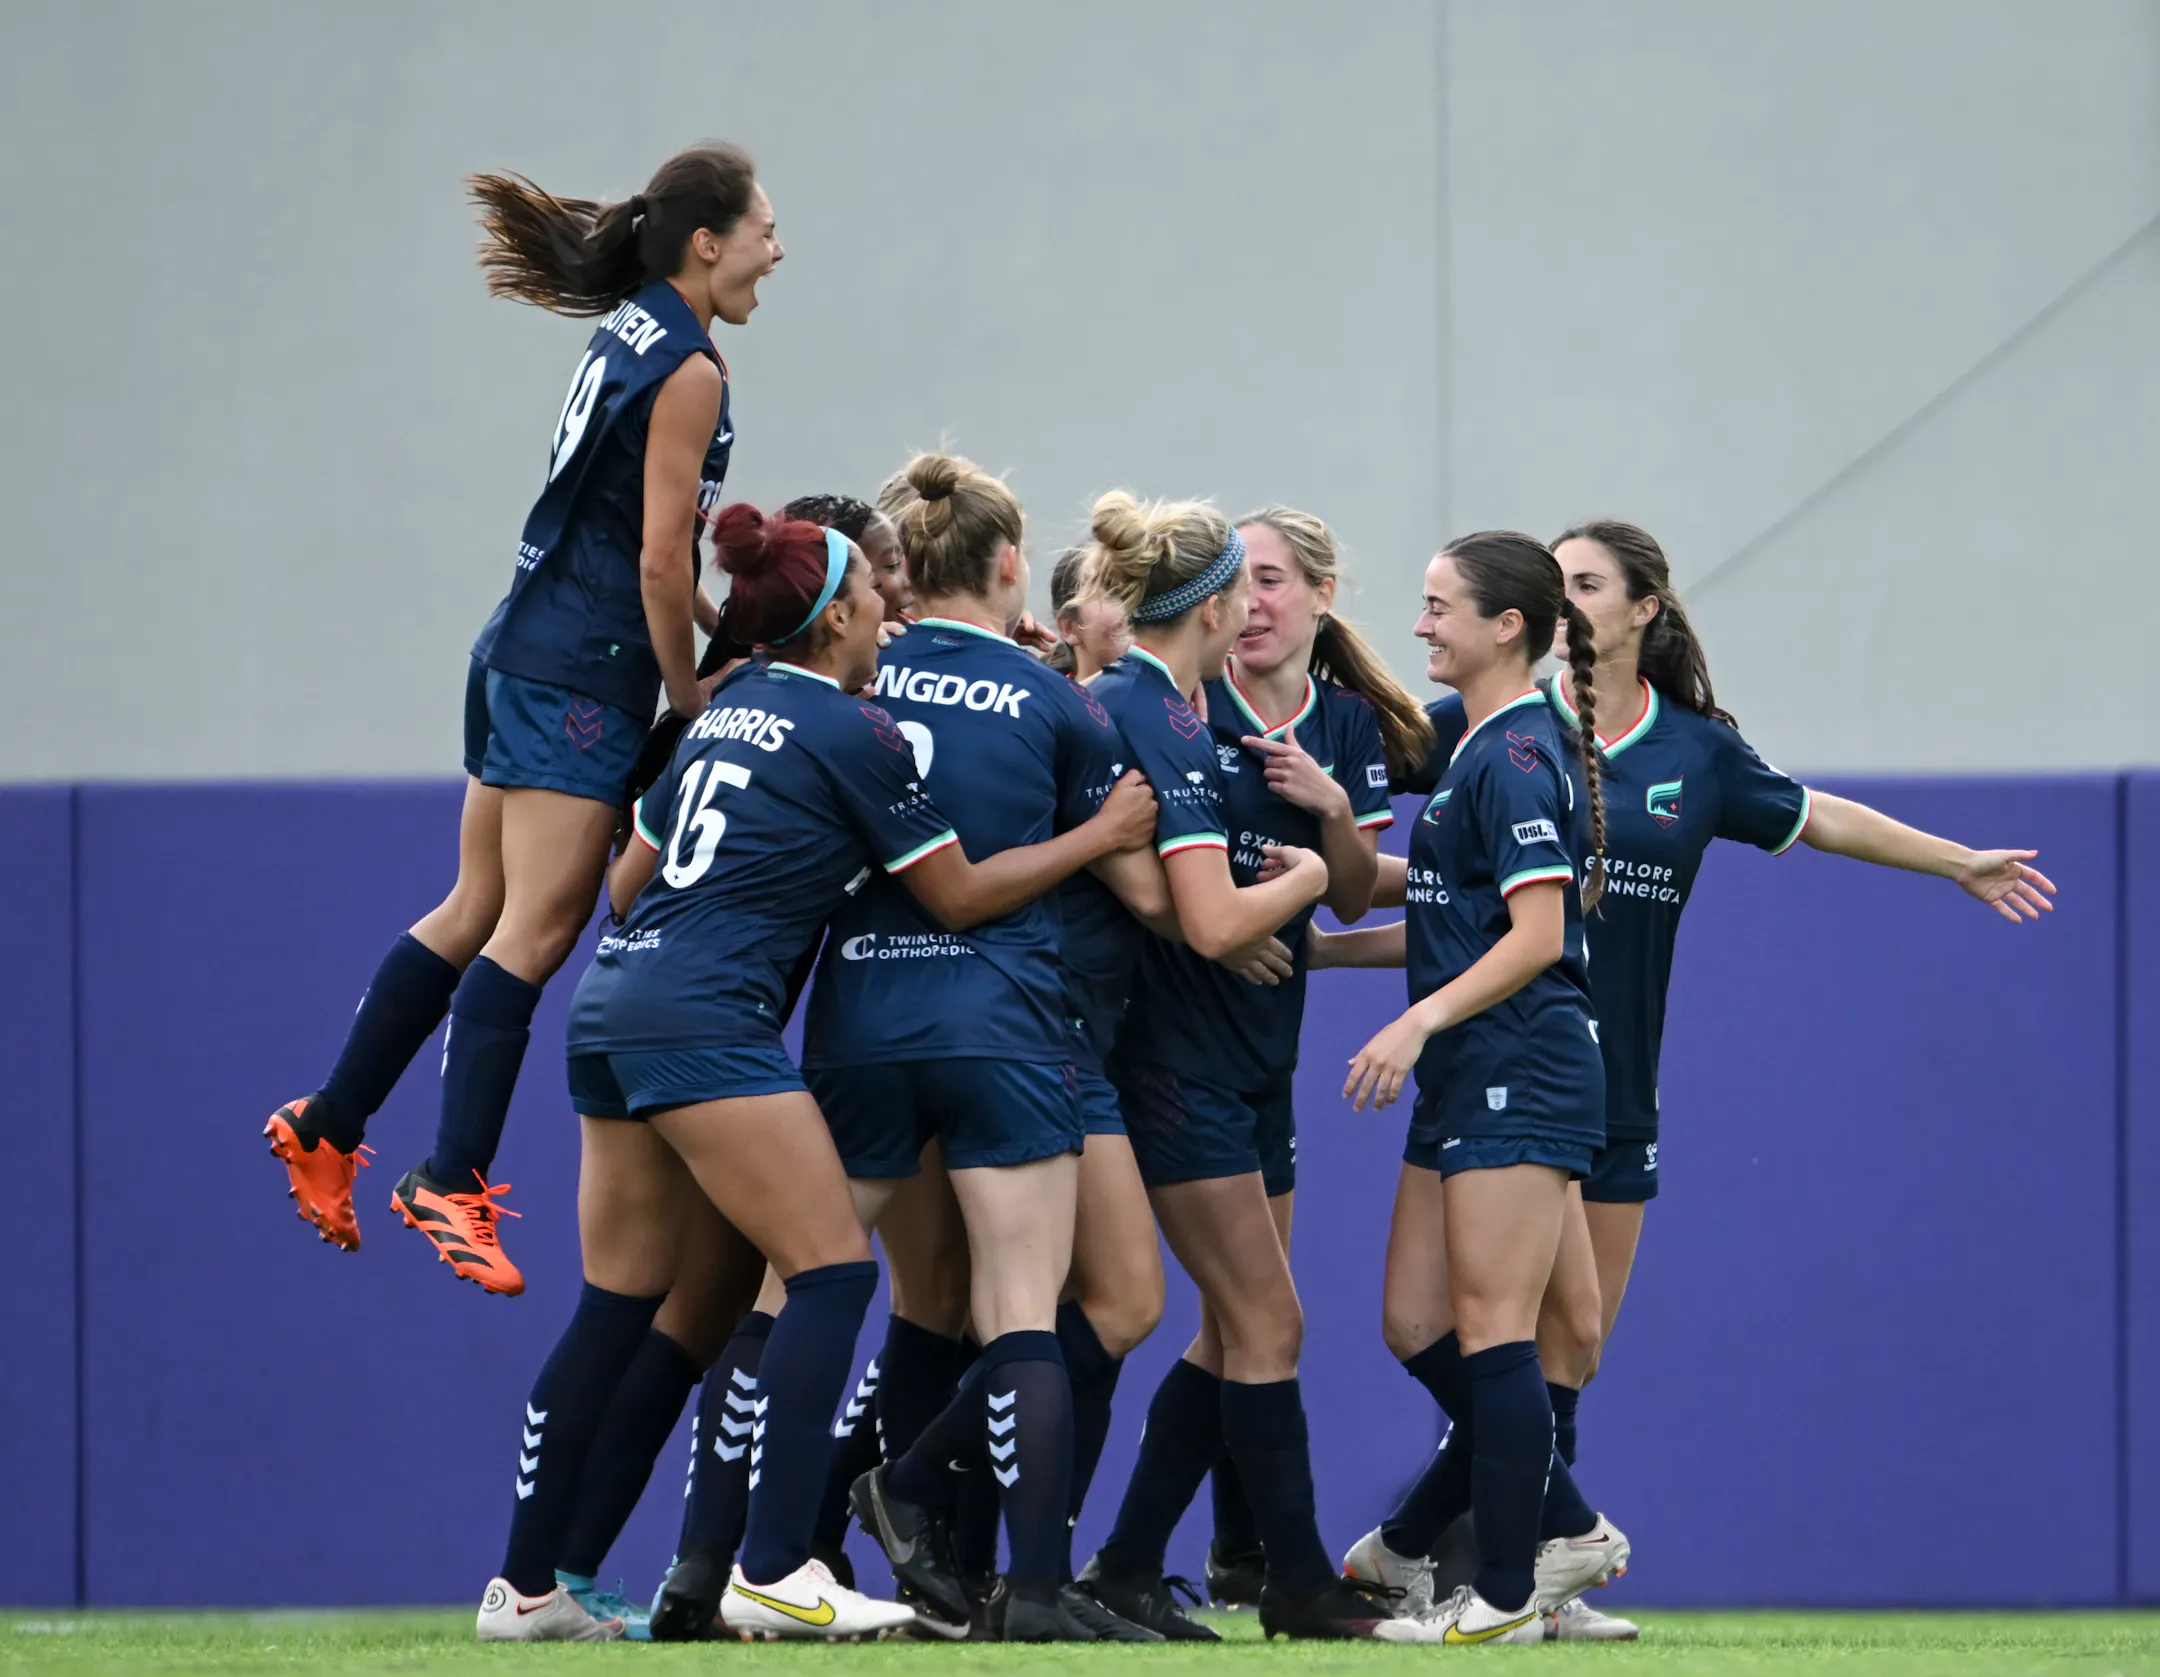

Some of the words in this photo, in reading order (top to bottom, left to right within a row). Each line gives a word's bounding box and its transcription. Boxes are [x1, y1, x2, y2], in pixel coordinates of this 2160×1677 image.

[550, 349, 606, 484] 19
[687, 707, 796, 752] HARRIS
[661, 760, 752, 890] 15
